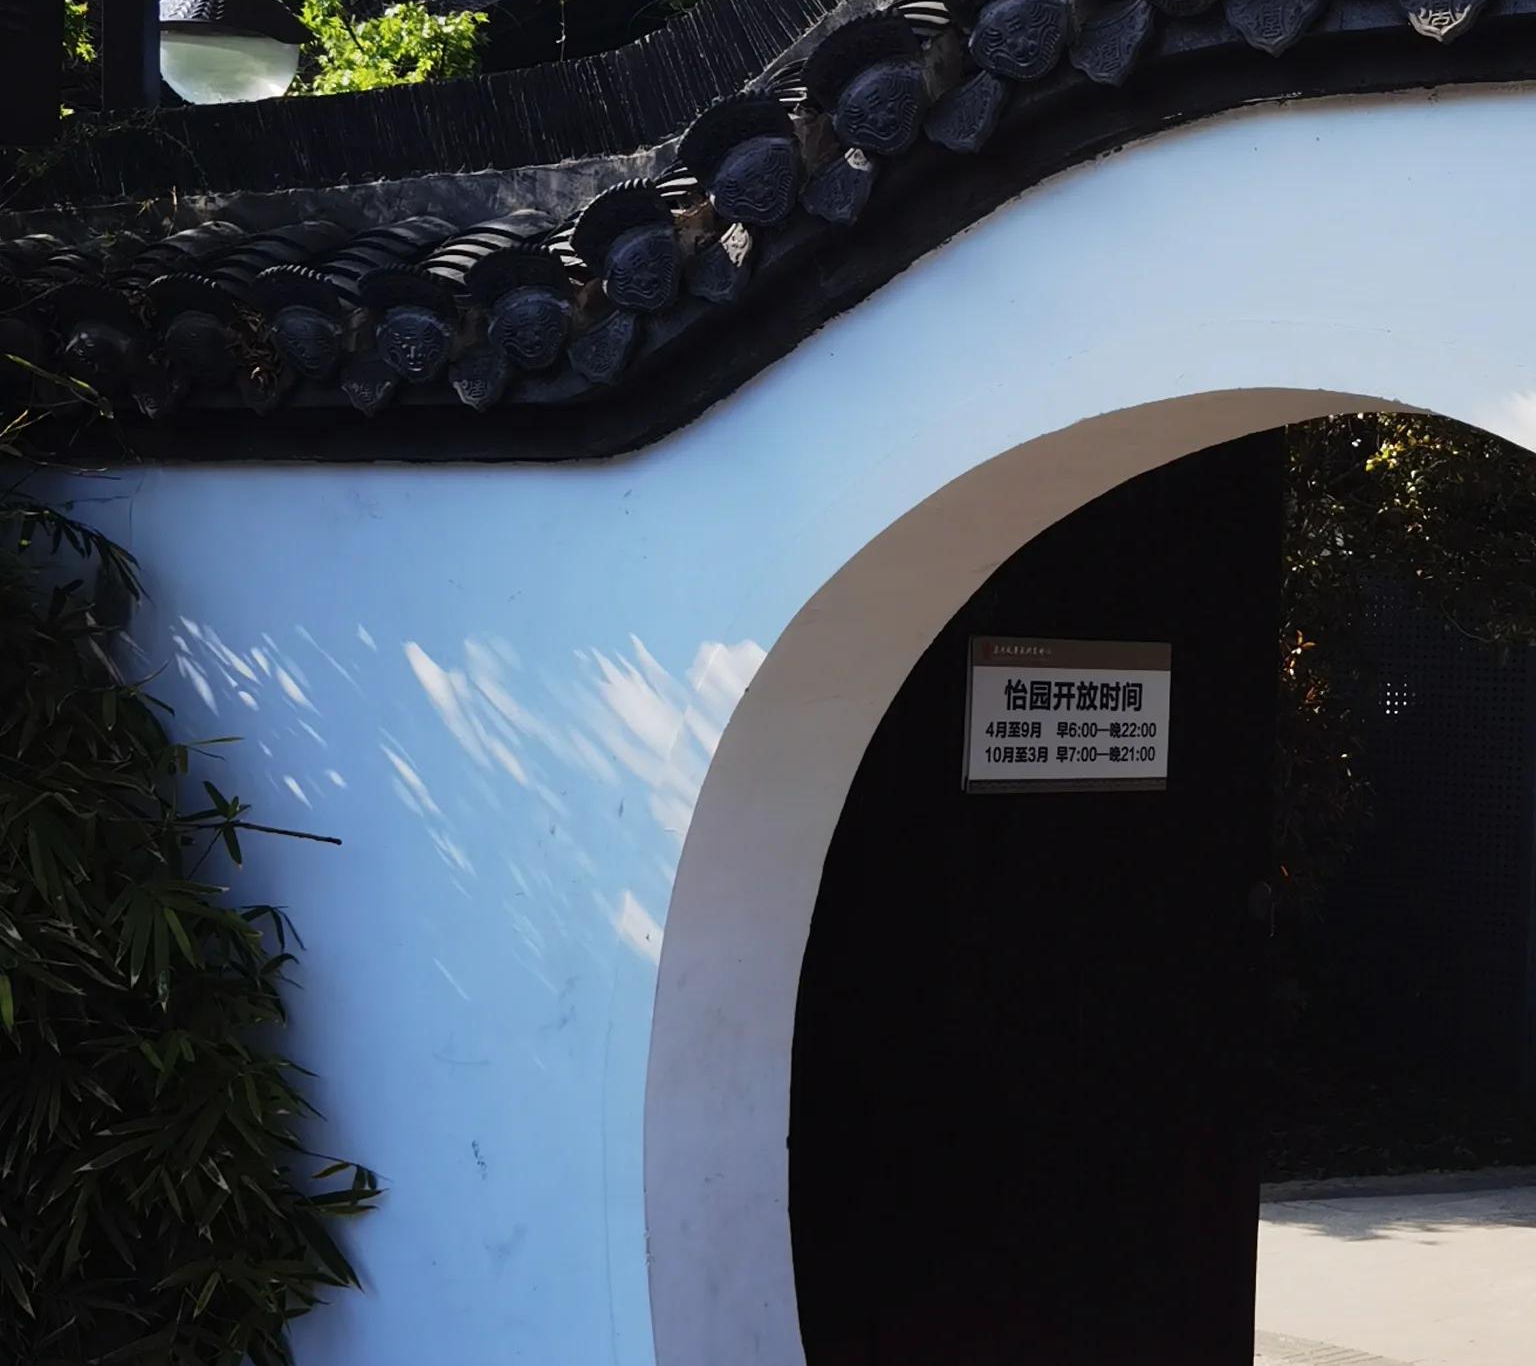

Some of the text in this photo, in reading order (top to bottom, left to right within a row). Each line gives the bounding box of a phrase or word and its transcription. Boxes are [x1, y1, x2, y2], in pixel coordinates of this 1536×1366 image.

[1003, 678, 1144, 713] 怡园开放时间
[984, 721, 1042, 739] 4月至9月
[984, 746, 1049, 764] 10月至3月
